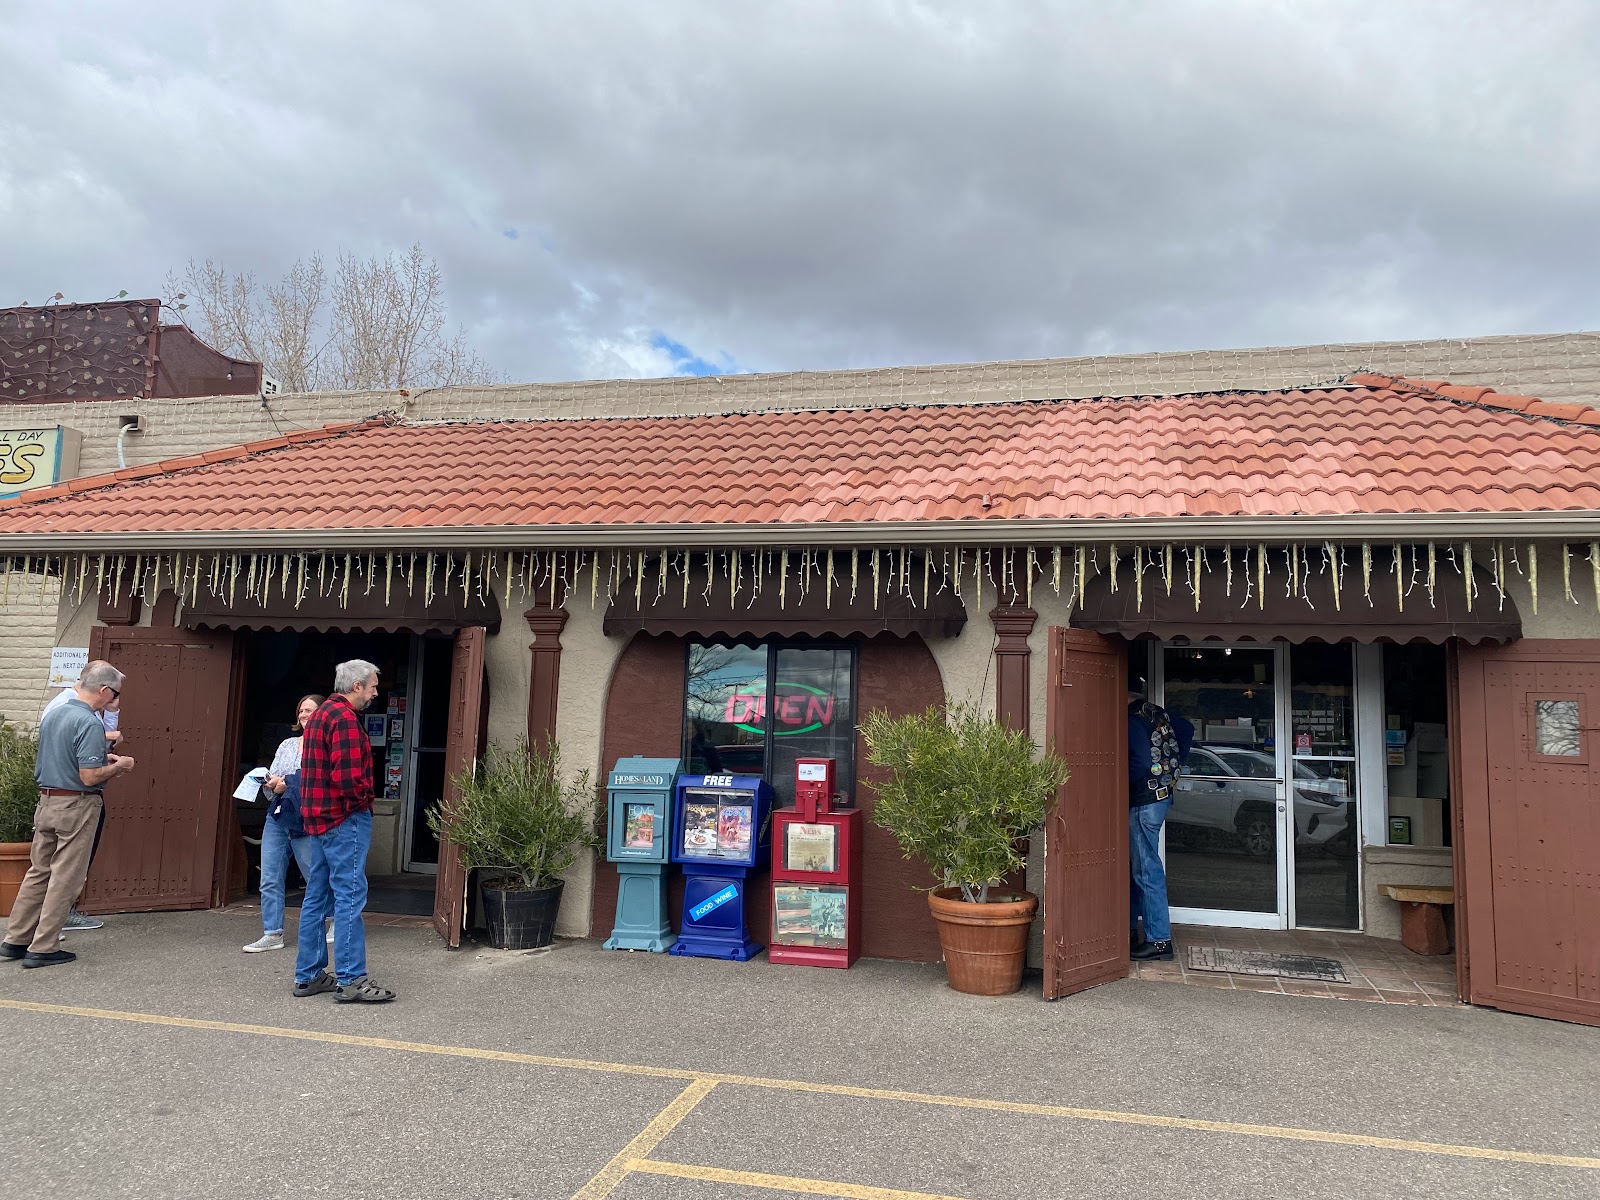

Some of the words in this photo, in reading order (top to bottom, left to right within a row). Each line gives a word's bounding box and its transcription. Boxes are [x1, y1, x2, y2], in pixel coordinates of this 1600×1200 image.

[0, 433, 10, 441] L
[17, 432, 44, 441] DAY
[724, 695, 835, 725] OPEN
[703, 775, 733, 786] FREE
[696, 902, 714, 916] FOOD
[715, 891, 733, 904] WINE
[813, 895, 844, 904] Sedona
